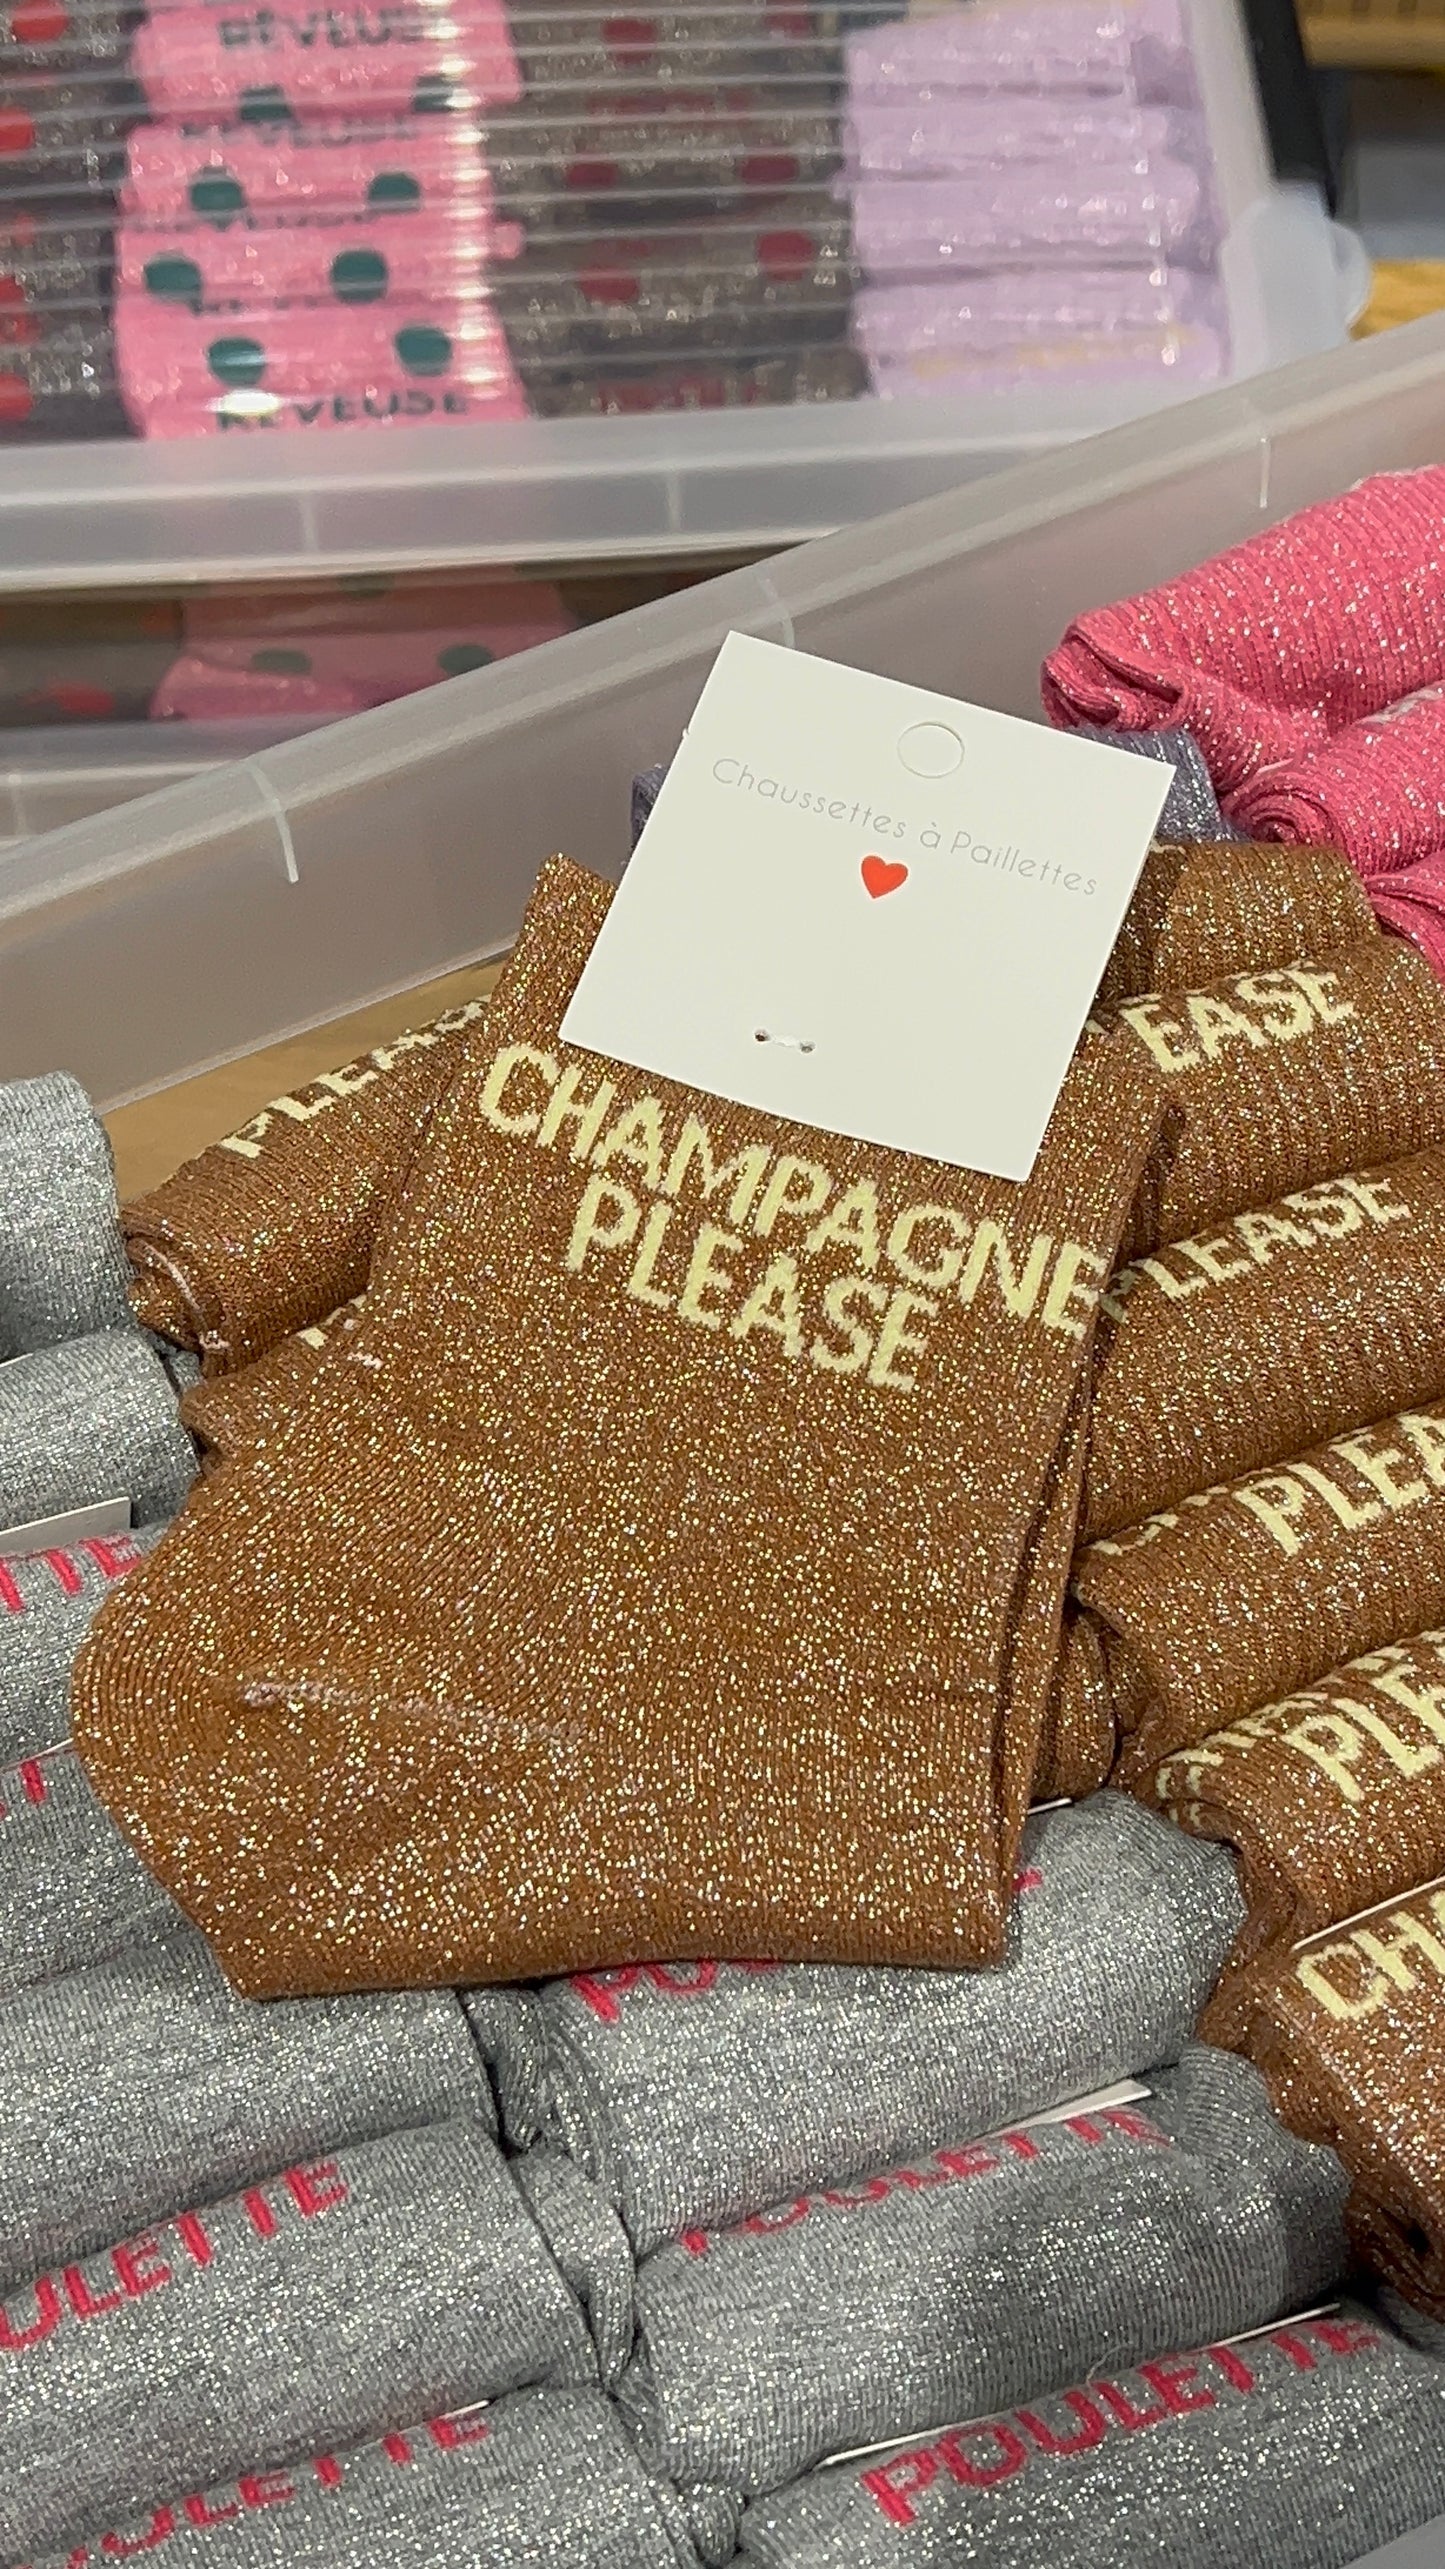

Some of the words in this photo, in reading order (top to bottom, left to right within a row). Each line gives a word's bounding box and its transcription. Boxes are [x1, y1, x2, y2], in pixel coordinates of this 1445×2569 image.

[712, 757, 906, 838] Chaussettes
[919, 822, 942, 850] à
[950, 830, 1098, 897] Paillettes
[1084, 968, 1355, 1073] EASE
[477, 1043, 1107, 1341] CHAMPAGNE
[567, 1173, 938, 1393] PLEASE
[860, 2319, 1379, 2527] POULETTE
